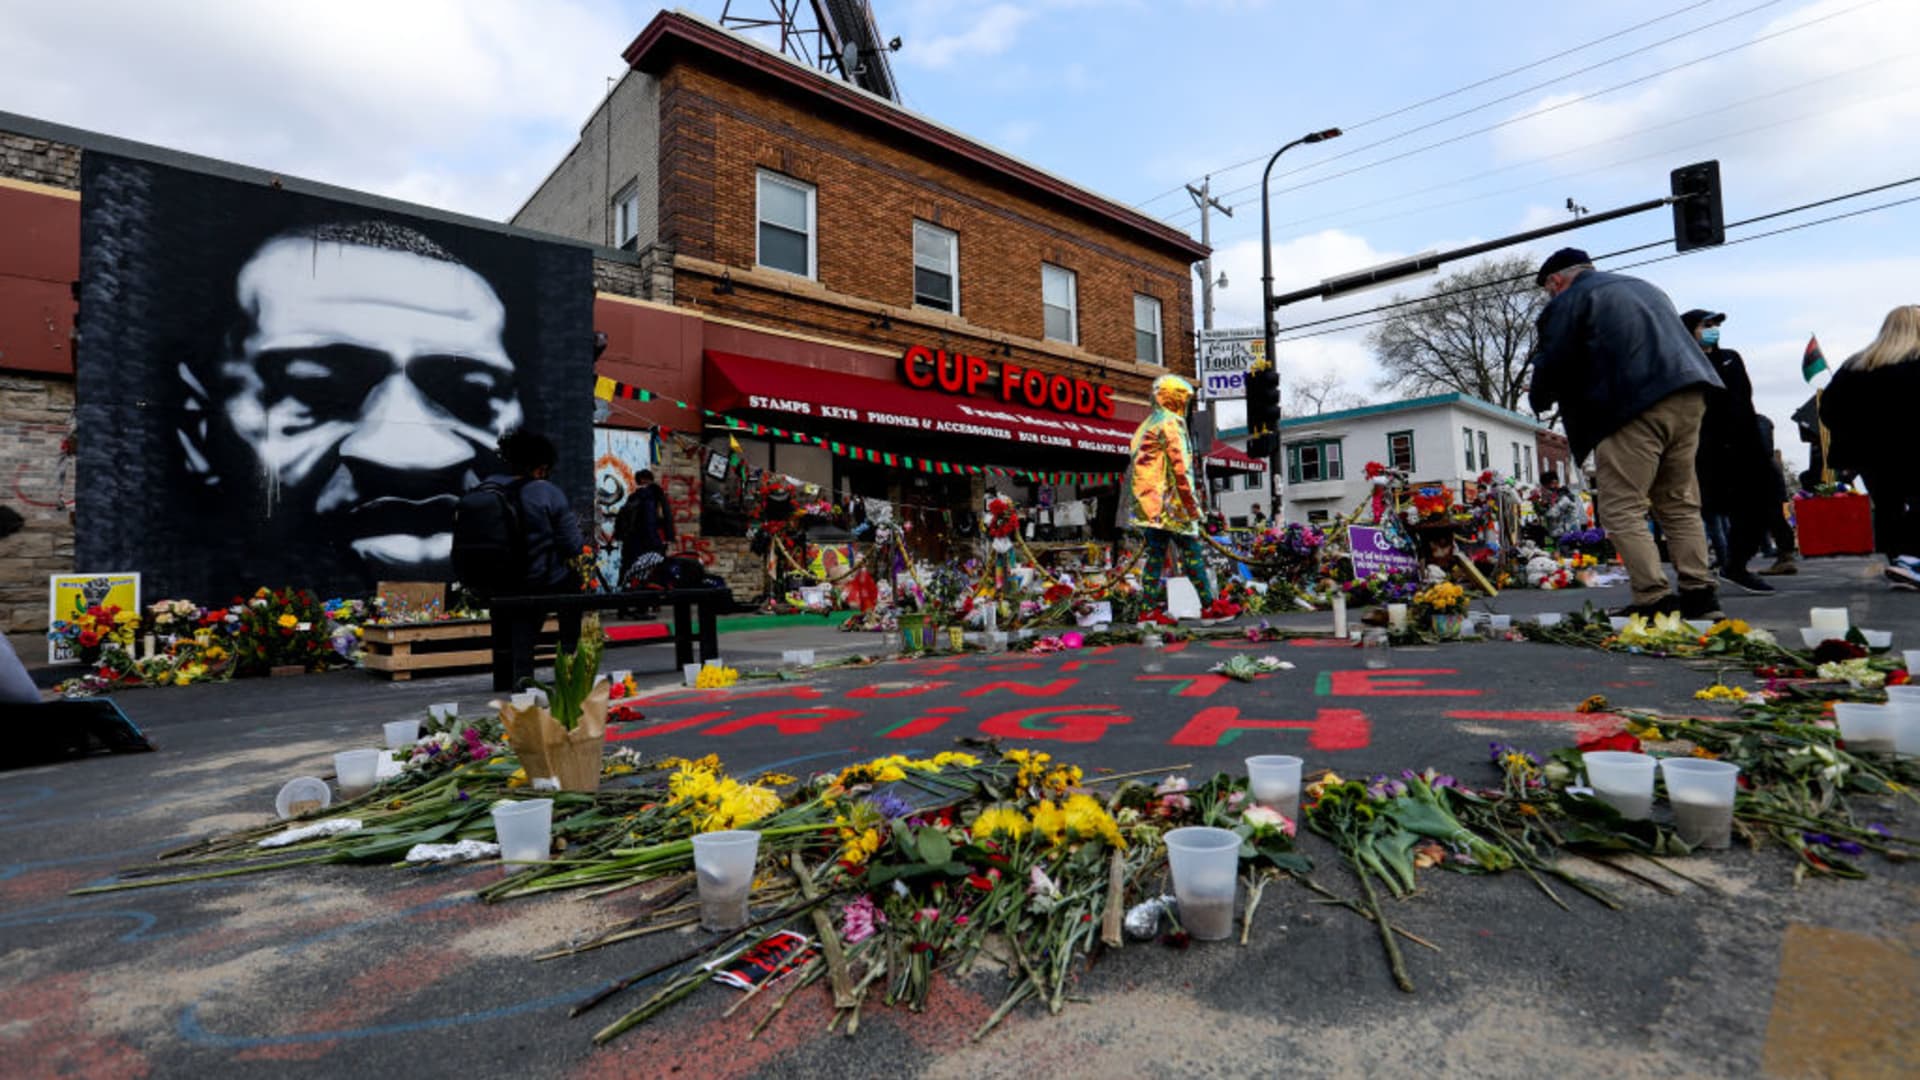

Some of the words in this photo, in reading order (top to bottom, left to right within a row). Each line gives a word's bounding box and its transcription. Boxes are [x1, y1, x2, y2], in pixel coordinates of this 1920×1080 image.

[904, 345, 989, 394] CUP
[1002, 362, 1115, 419] FOODS
[1208, 371, 1249, 389] met
[749, 395, 811, 415] STAMPS
[820, 405, 859, 421] KEYS
[867, 411, 919, 428] PHONES
[936, 420, 1012, 440] ACCESSORIES
